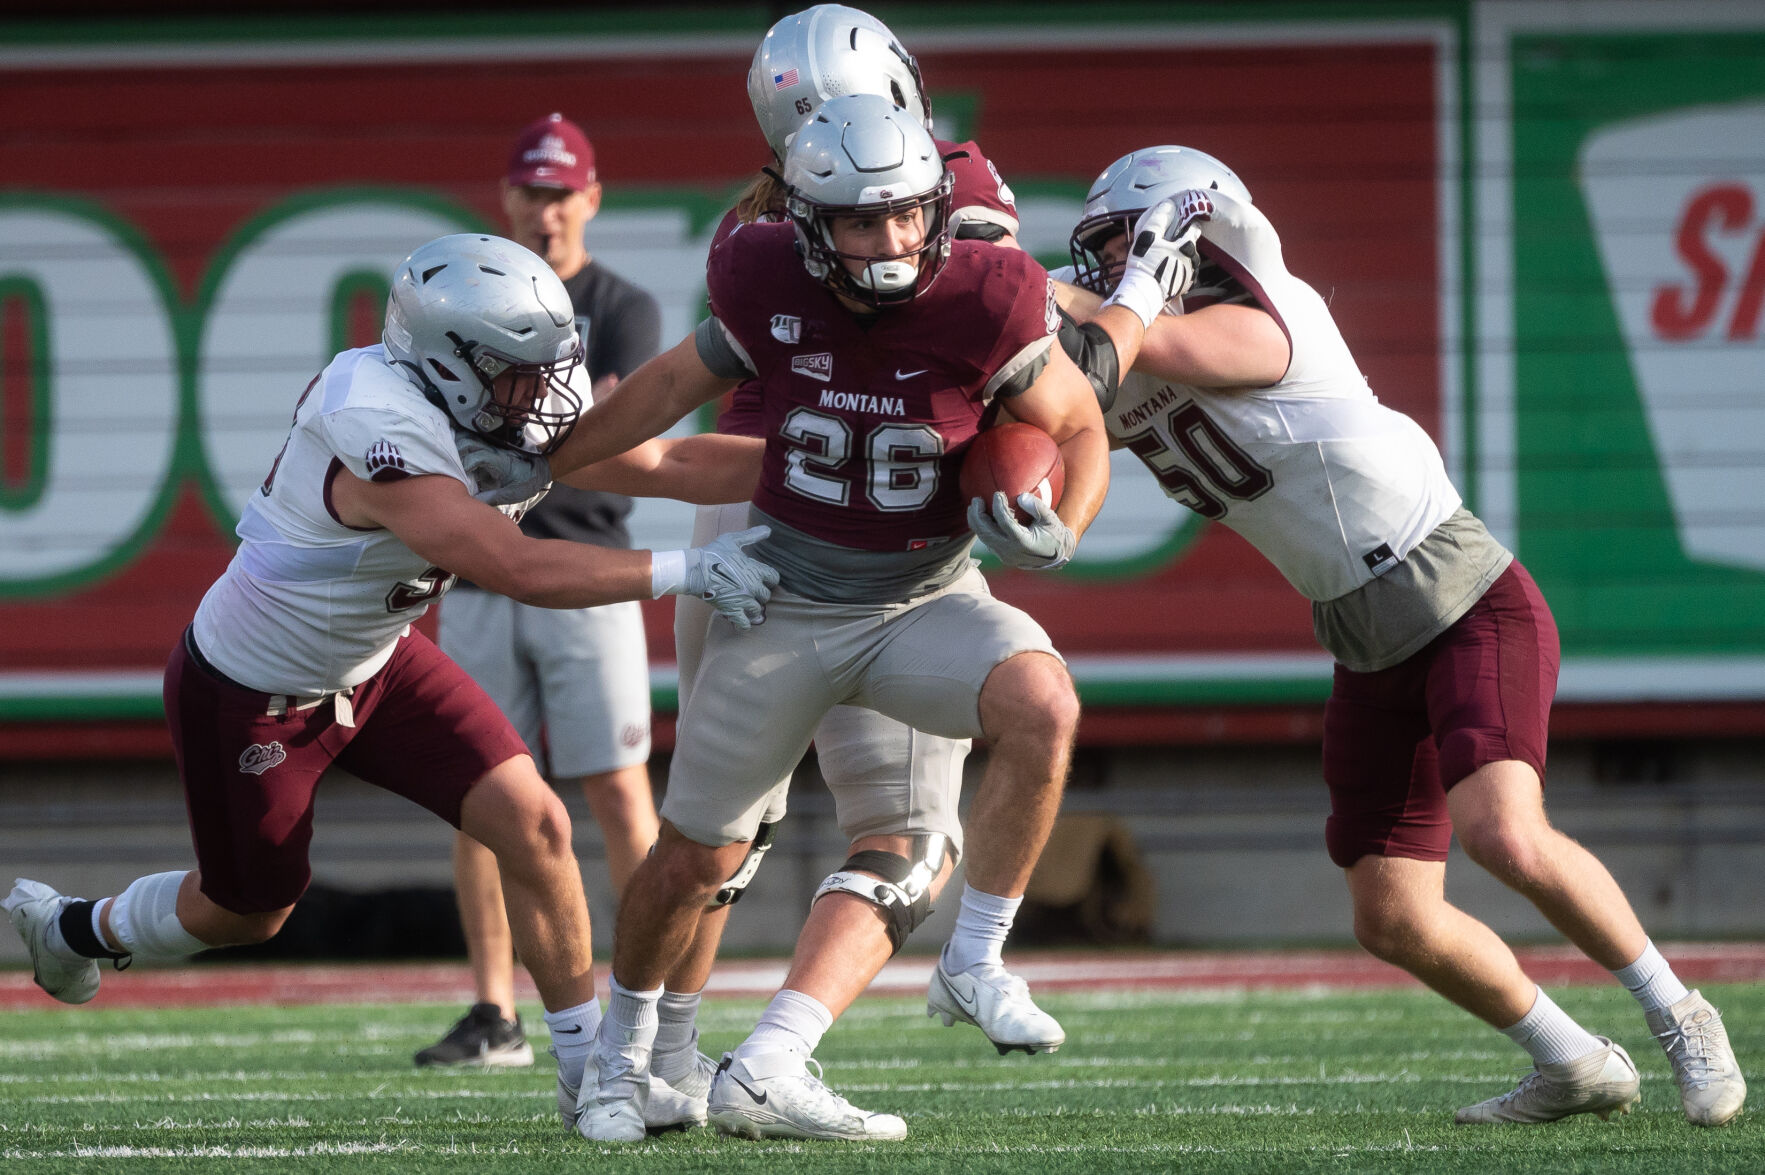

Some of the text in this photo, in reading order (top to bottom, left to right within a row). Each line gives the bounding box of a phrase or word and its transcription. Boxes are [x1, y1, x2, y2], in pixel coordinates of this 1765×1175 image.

[795, 97, 812, 115] 65
[818, 389, 906, 416] MONTANA
[1119, 384, 1178, 431] MONTANA
[779, 405, 944, 512] 26
[1119, 398, 1275, 521] 50
[1373, 553, 1384, 562] L
